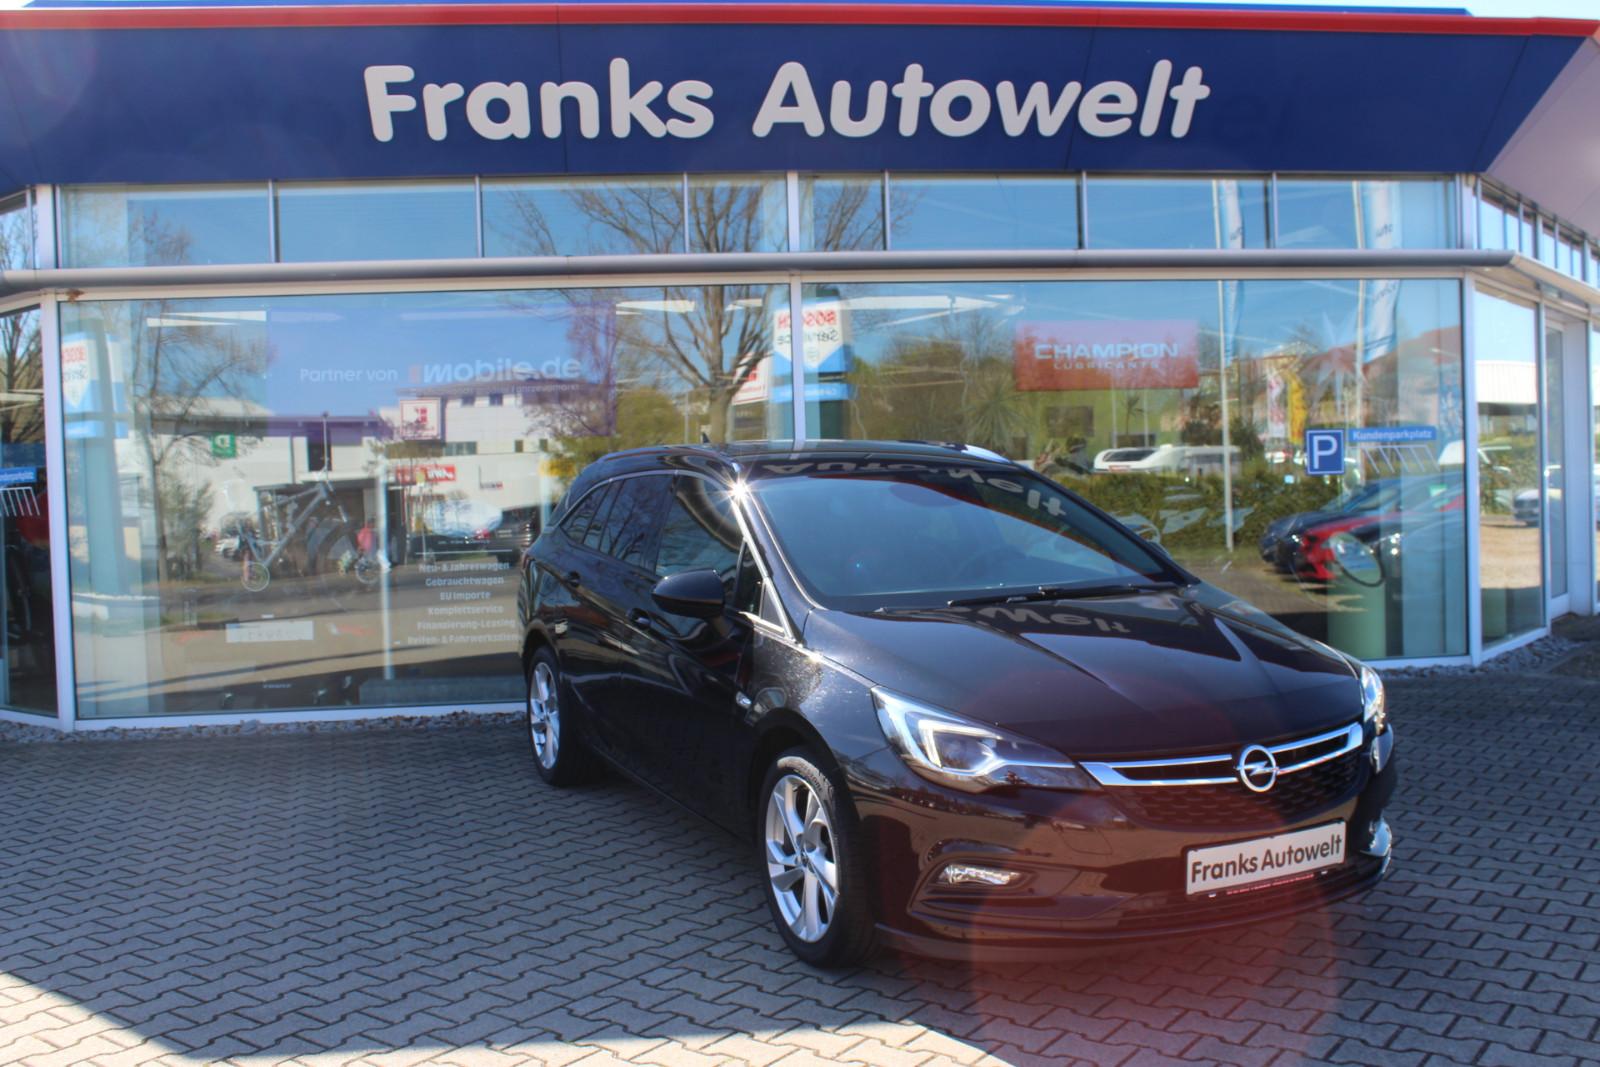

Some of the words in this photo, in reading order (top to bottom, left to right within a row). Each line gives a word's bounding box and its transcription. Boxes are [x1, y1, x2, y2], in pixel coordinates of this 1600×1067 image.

[363, 57, 715, 142] Franks
[751, 59, 1212, 138] Autowelt
[1034, 343, 1179, 360] CHAMPION
[300, 368, 362, 382] Partner
[367, 370, 399, 382] von
[423, 356, 582, 383] mobile.de
[1312, 435, 1338, 469] P
[1191, 853, 1259, 884] Franks
[1261, 834, 1343, 871] Autowelt
